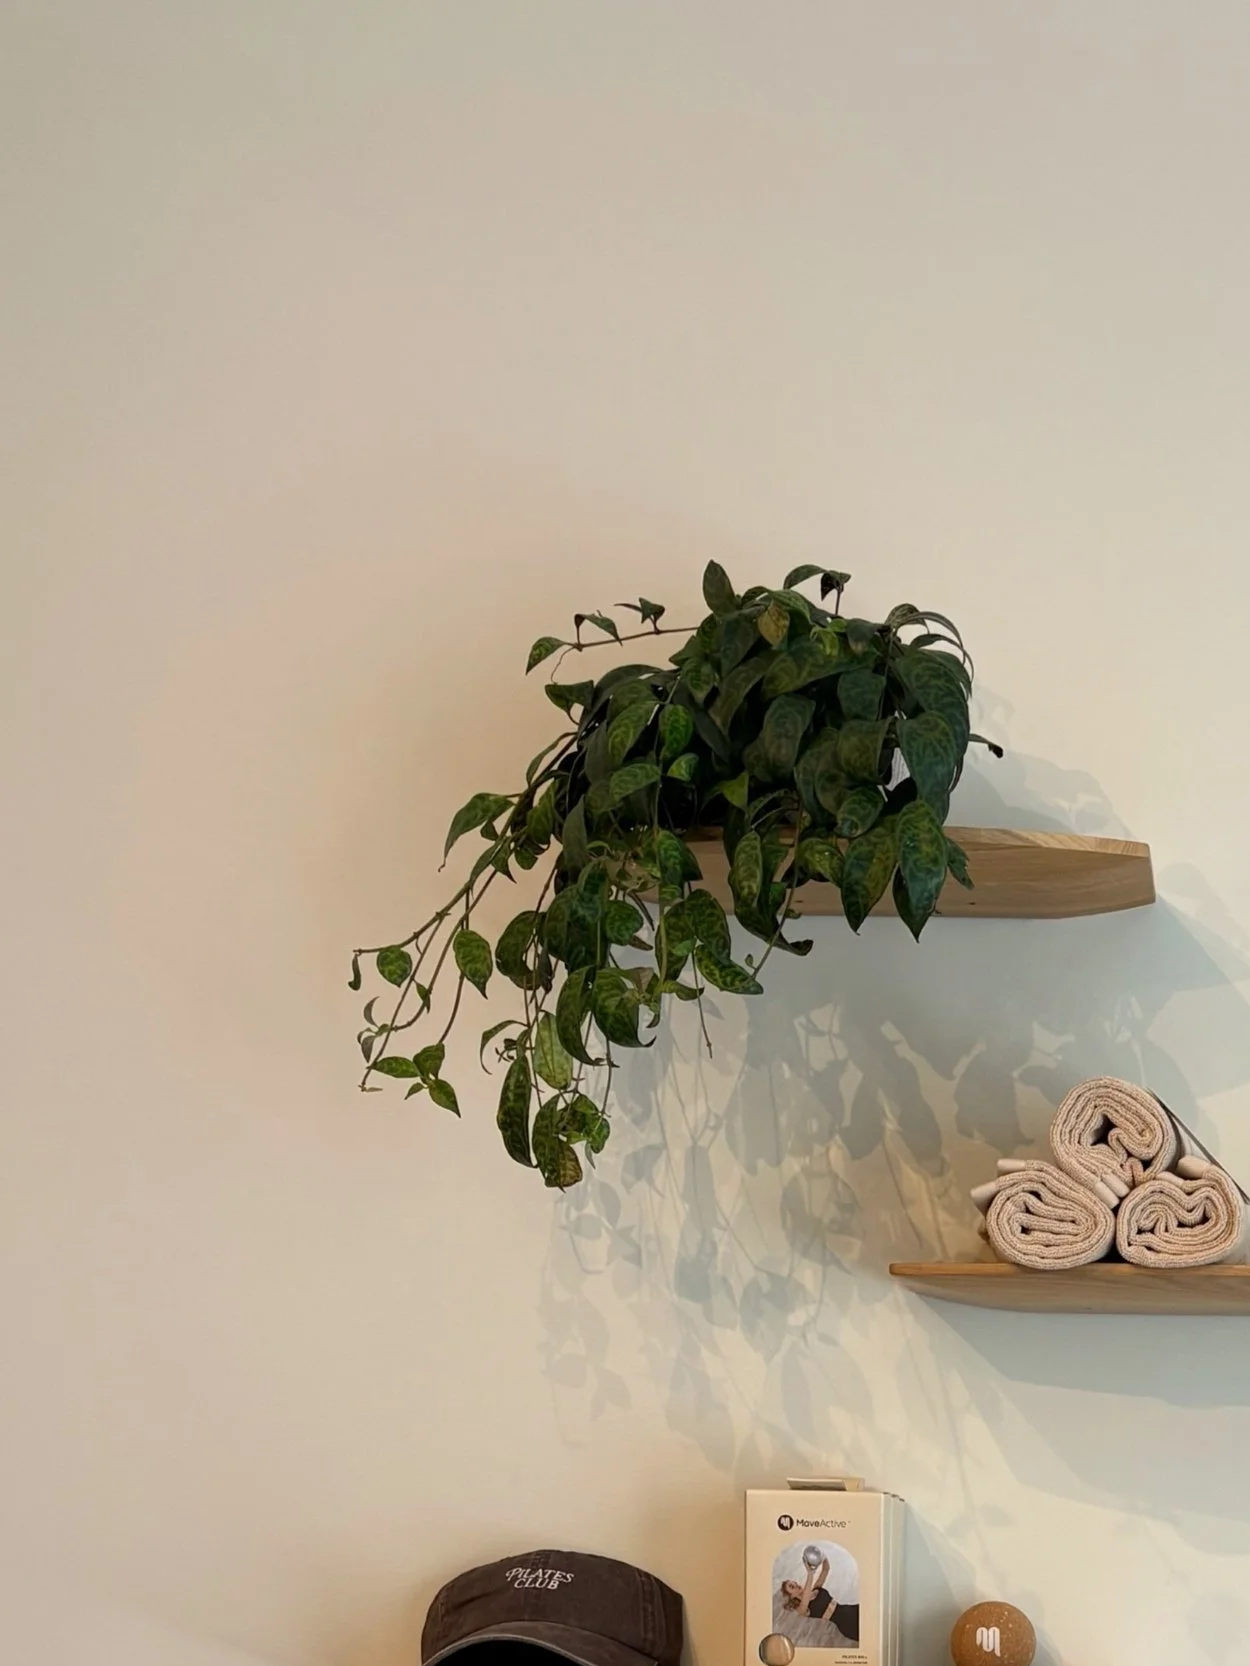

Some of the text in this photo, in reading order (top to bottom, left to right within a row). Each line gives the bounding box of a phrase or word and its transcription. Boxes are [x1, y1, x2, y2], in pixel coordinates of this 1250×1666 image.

[796, 1519, 847, 1528] MoveActive
[505, 1567, 575, 1583] PILATES
[513, 1578, 559, 1590] CLUB
